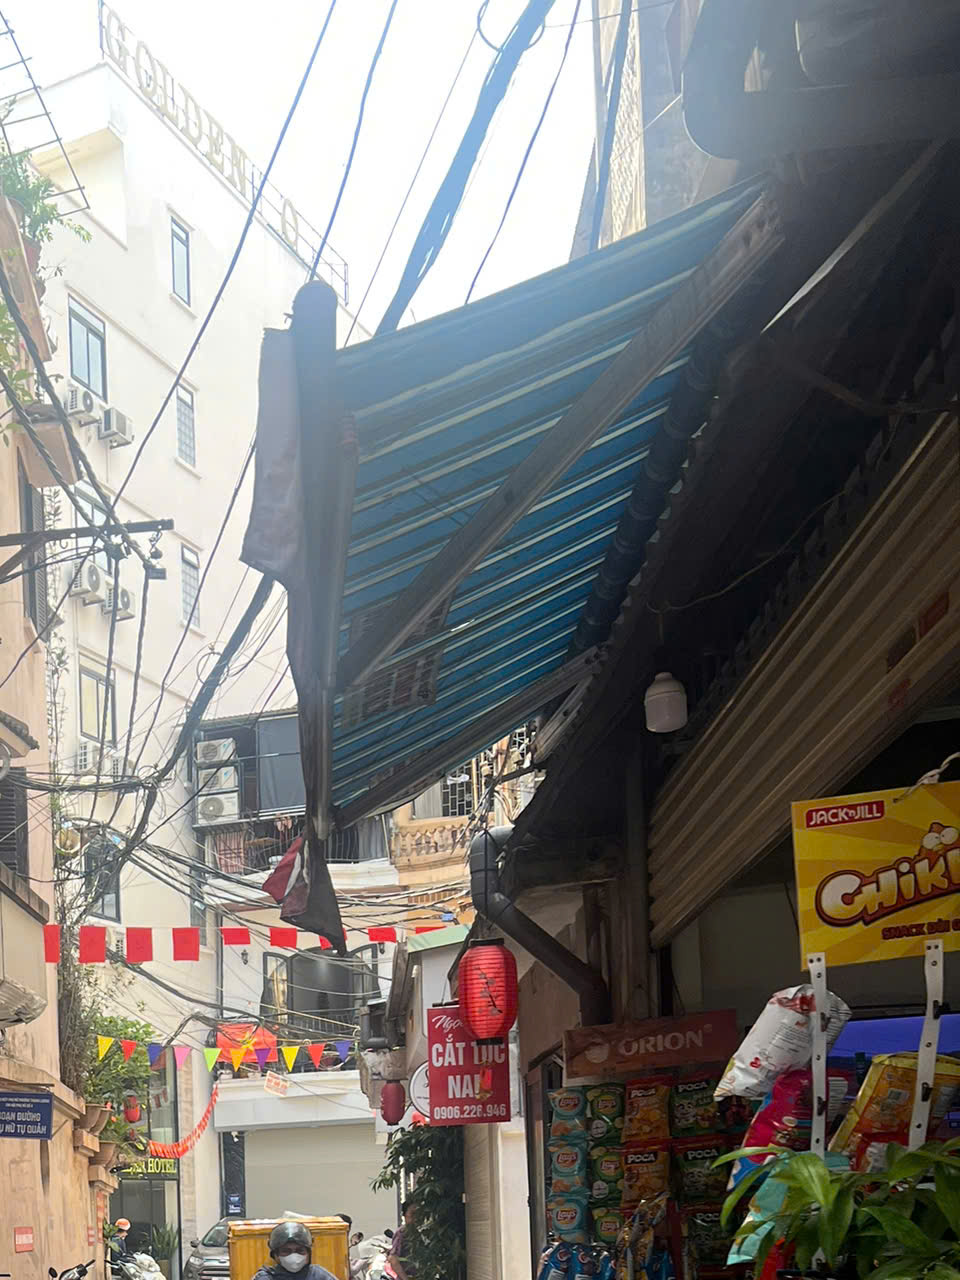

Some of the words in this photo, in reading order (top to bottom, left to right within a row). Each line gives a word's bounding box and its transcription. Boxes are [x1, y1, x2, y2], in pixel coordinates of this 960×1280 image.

[105, 8, 246, 198] GOLDEN
[882, 923, 926, 940] SNACK
[432, 1015, 464, 1033] Ngọ
[432, 1034, 466, 1067] CẮT
[618, 1030, 703, 1056] ORION
[147, 1158, 177, 1173] HOTEL
[627, 1152, 656, 1164] POCA
[696, 1212, 720, 1222] POC
